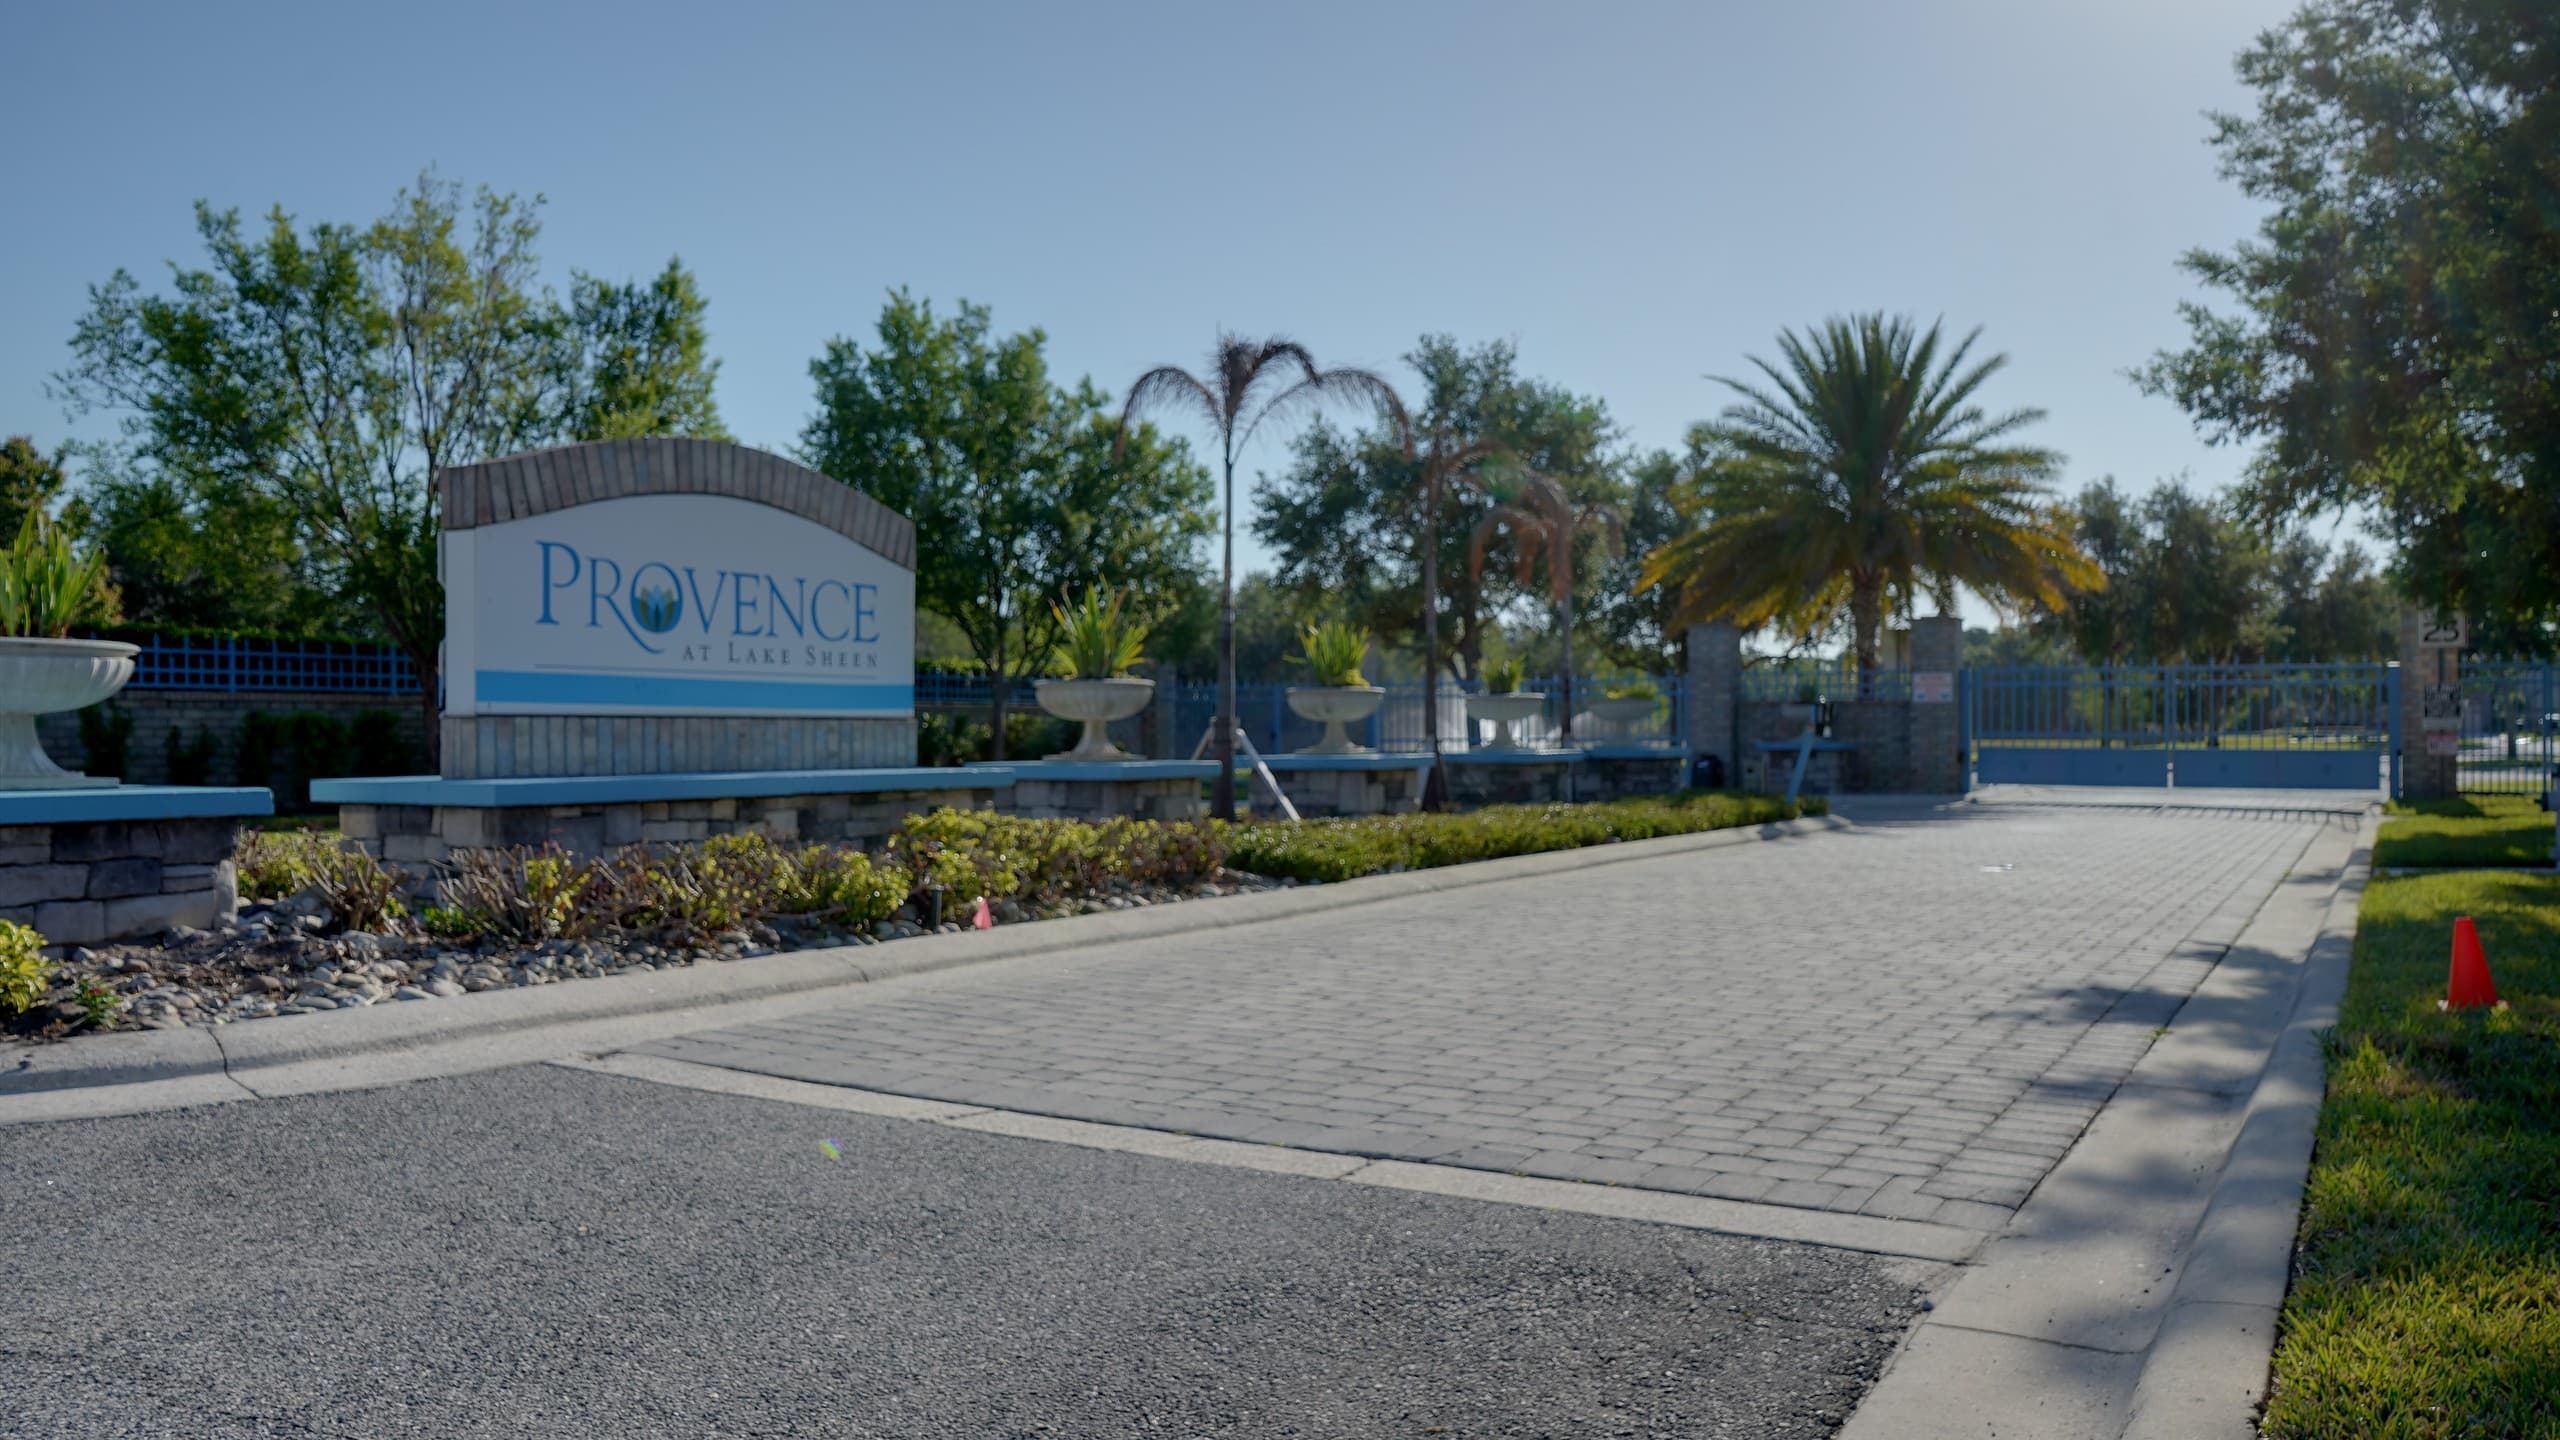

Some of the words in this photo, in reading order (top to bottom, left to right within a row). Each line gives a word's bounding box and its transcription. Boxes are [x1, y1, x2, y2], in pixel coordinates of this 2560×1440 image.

[535, 540, 880, 654] PROVENCE
[682, 644, 712, 662] AT
[727, 641, 791, 665] LAKE
[805, 644, 878, 668] SHEEN
